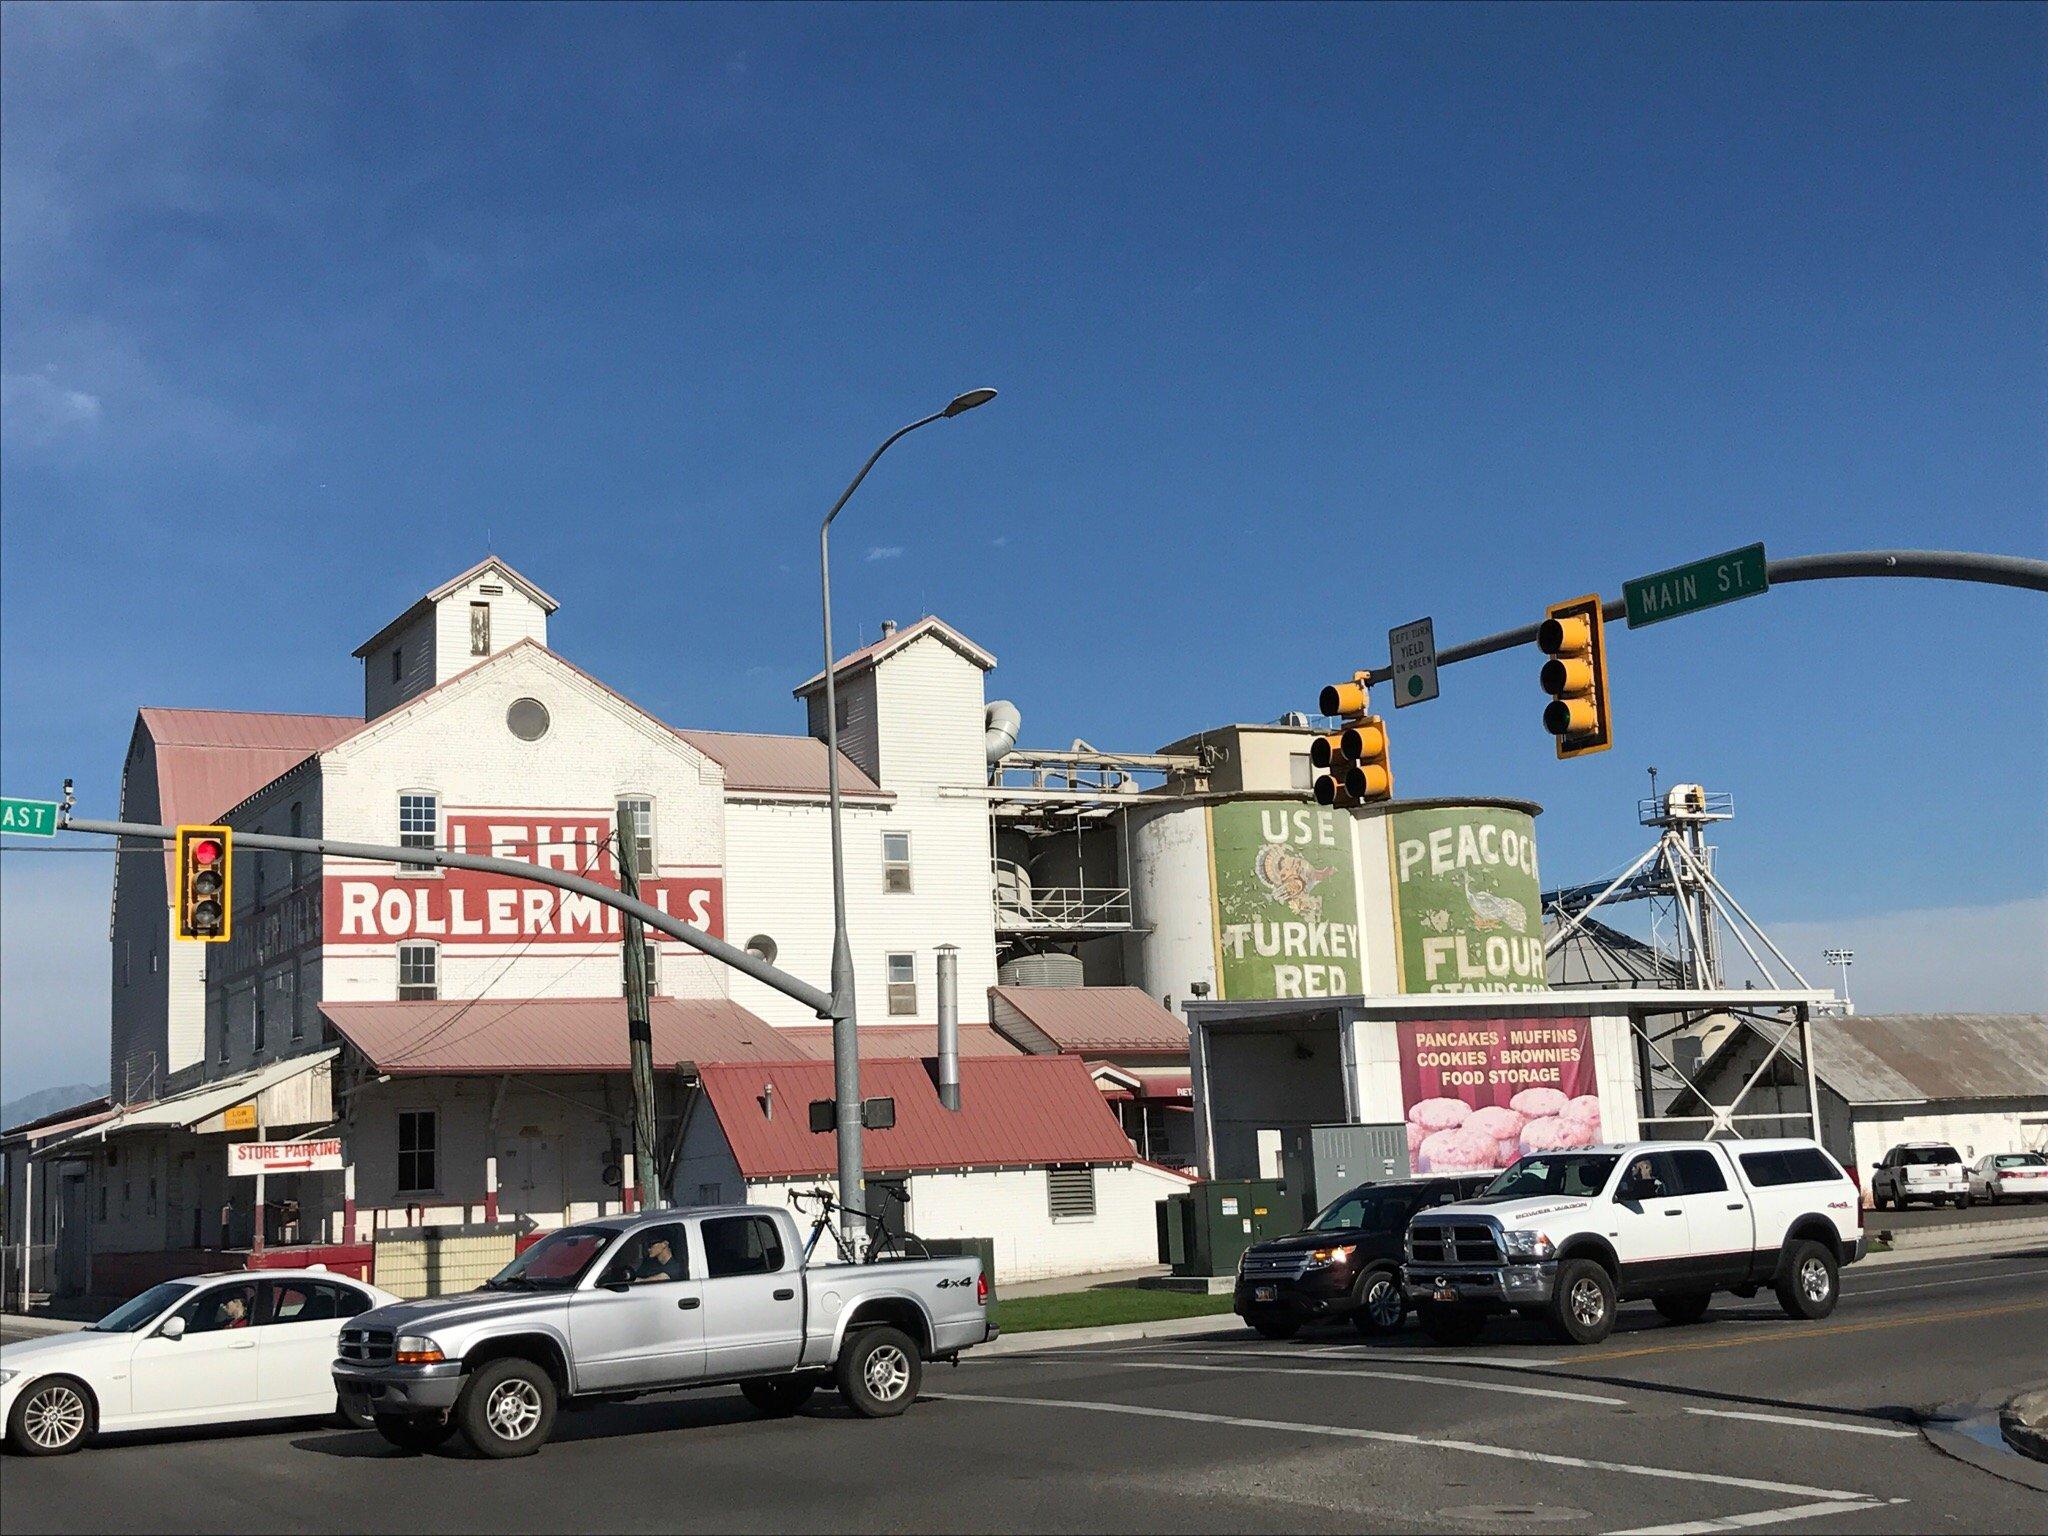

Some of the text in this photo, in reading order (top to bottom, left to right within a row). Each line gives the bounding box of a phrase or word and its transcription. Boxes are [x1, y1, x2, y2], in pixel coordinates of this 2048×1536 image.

[1641, 574, 1698, 614] MAIN
[1401, 641, 1424, 659] YIELD
[1396, 656, 1432, 674] ON GREEN
[1261, 810, 1335, 845] USE
[1226, 921, 1358, 959] TURKEY
[1423, 936, 1544, 980] FLOUR
[1274, 964, 1347, 999] RED
[1415, 1029, 1578, 1047] PANCAKES MUFFINS
[1417, 1048, 1581, 1067] COOKIES BROWNIES
[1441, 1068, 1561, 1086] FOOD STORAGE
[238, 1141, 341, 1160] STORE PARKING
